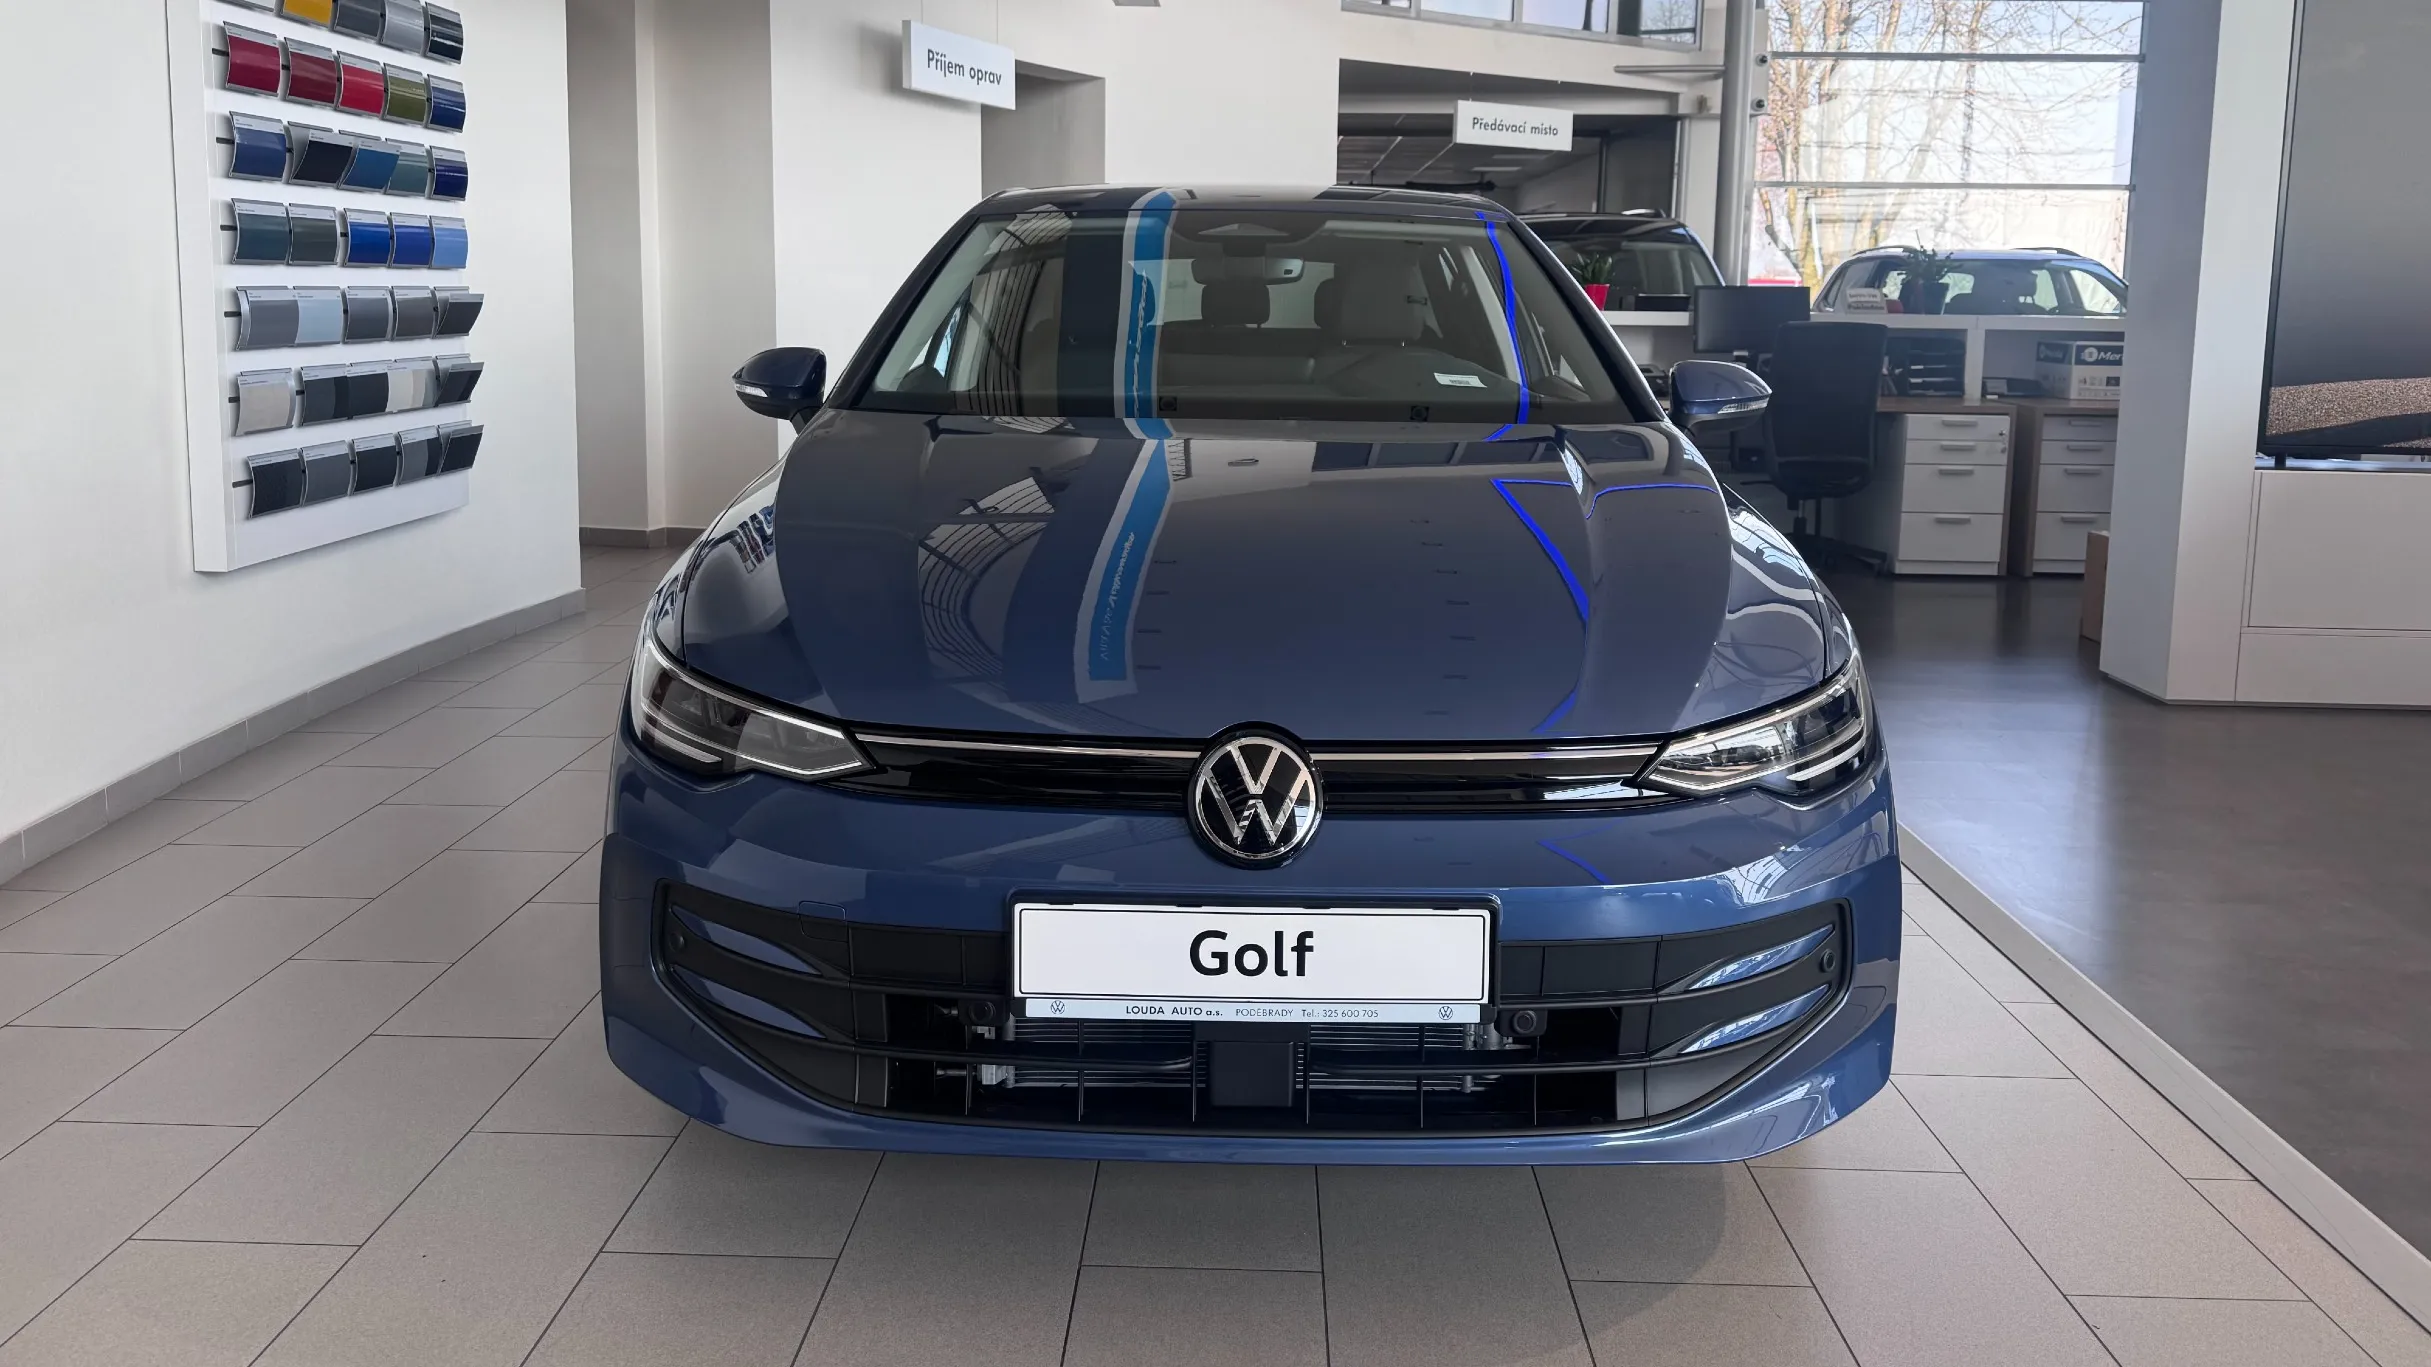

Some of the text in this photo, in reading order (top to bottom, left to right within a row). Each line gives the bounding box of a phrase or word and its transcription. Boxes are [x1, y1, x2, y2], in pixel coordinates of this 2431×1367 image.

[927, 48, 1002, 85] Příjem oprav
[1472, 117, 1559, 136] Předávací místo
[1189, 929, 1314, 977] Golf
[1126, 1005, 1165, 1015] LOUDA
[1171, 1006, 1203, 1016] AUTO
[1301, 1009, 1320, 1018] Tel.:
[1322, 1009, 1339, 1018] 325
[1341, 1009, 1360, 1018] 600
[1362, 1009, 1379, 1018] 705
